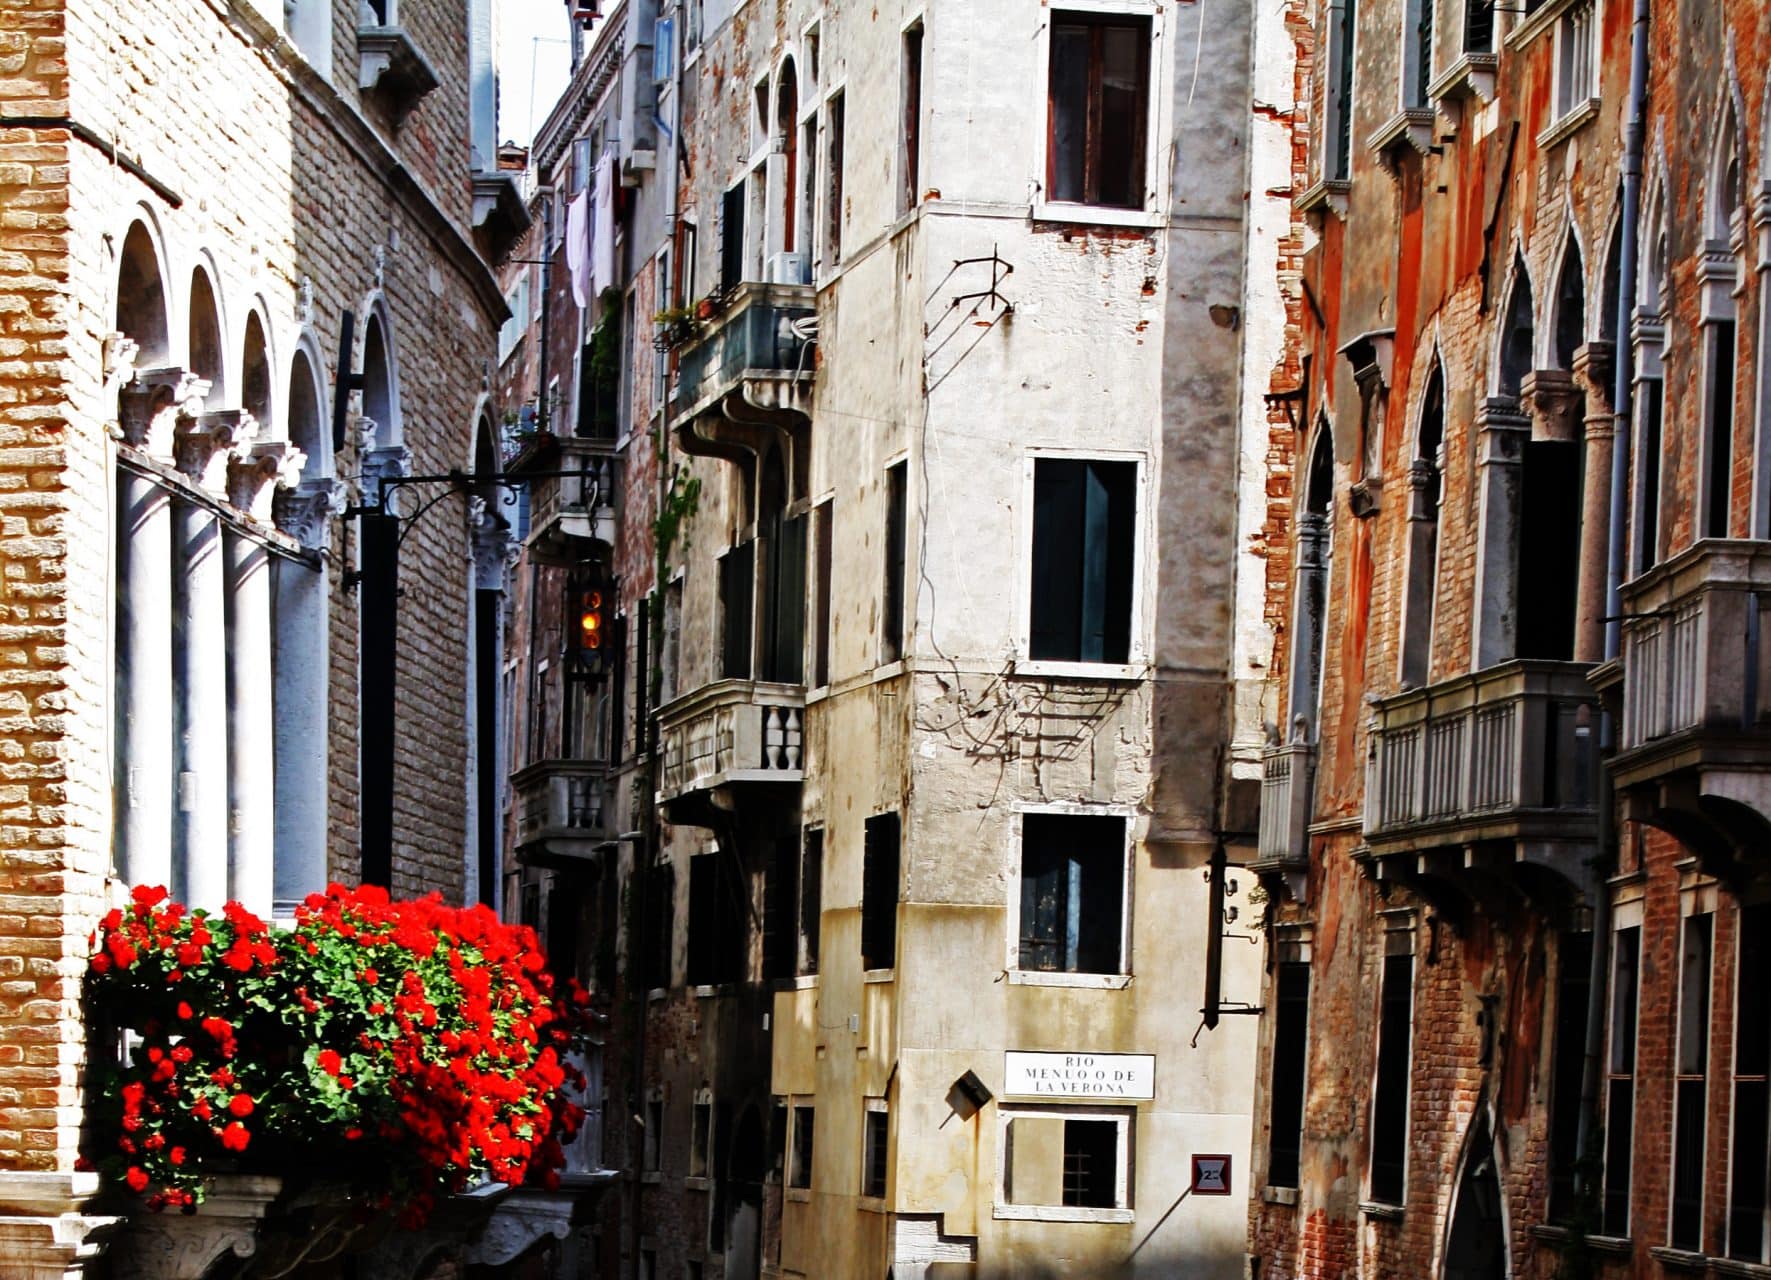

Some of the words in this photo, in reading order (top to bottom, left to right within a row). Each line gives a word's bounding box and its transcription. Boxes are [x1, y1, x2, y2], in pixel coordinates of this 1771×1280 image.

[1066, 1056, 1094, 1067] RIO
[1026, 1068, 1087, 1080] MENUO
[1095, 1070, 1105, 1080] O
[1114, 1071, 1136, 1081] DE
[1035, 1081, 1054, 1092] LA
[1061, 1082, 1124, 1094] VERONA
